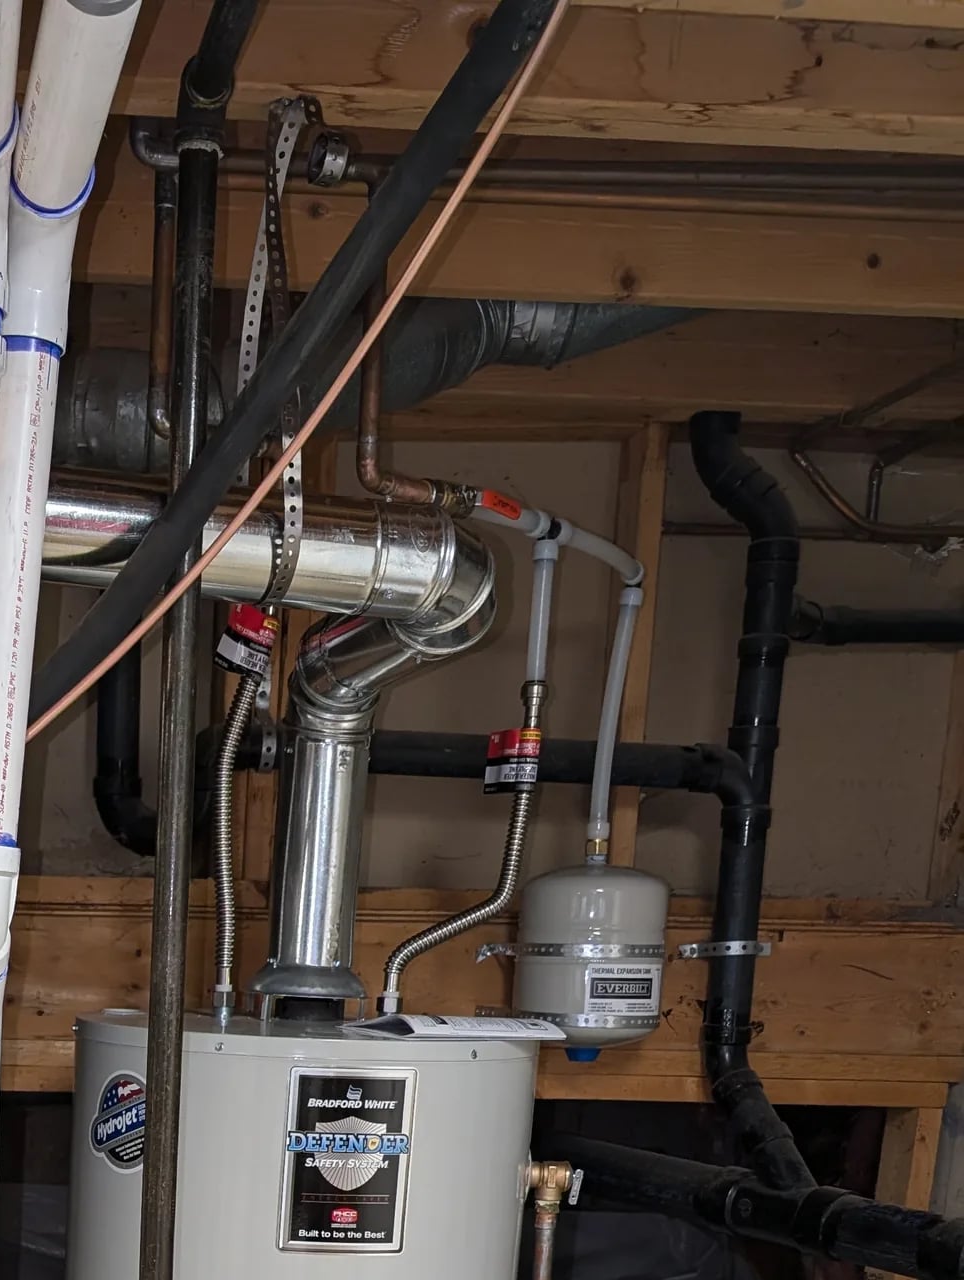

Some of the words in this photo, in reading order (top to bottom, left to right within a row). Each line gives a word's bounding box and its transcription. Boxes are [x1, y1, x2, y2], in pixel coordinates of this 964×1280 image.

[597, 984, 648, 993] EVERBILT
[307, 1098, 362, 1109] BRADFORD
[364, 1100, 396, 1110] WHITE
[97, 1106, 138, 1141] Hydrojet
[288, 1132, 409, 1154] DEFENDER
[305, 1157, 345, 1168] SAFETY
[347, 1159, 388, 1169] SYSTEM
[298, 1229, 319, 1238] Built
[364, 1231, 385, 1239] Best
